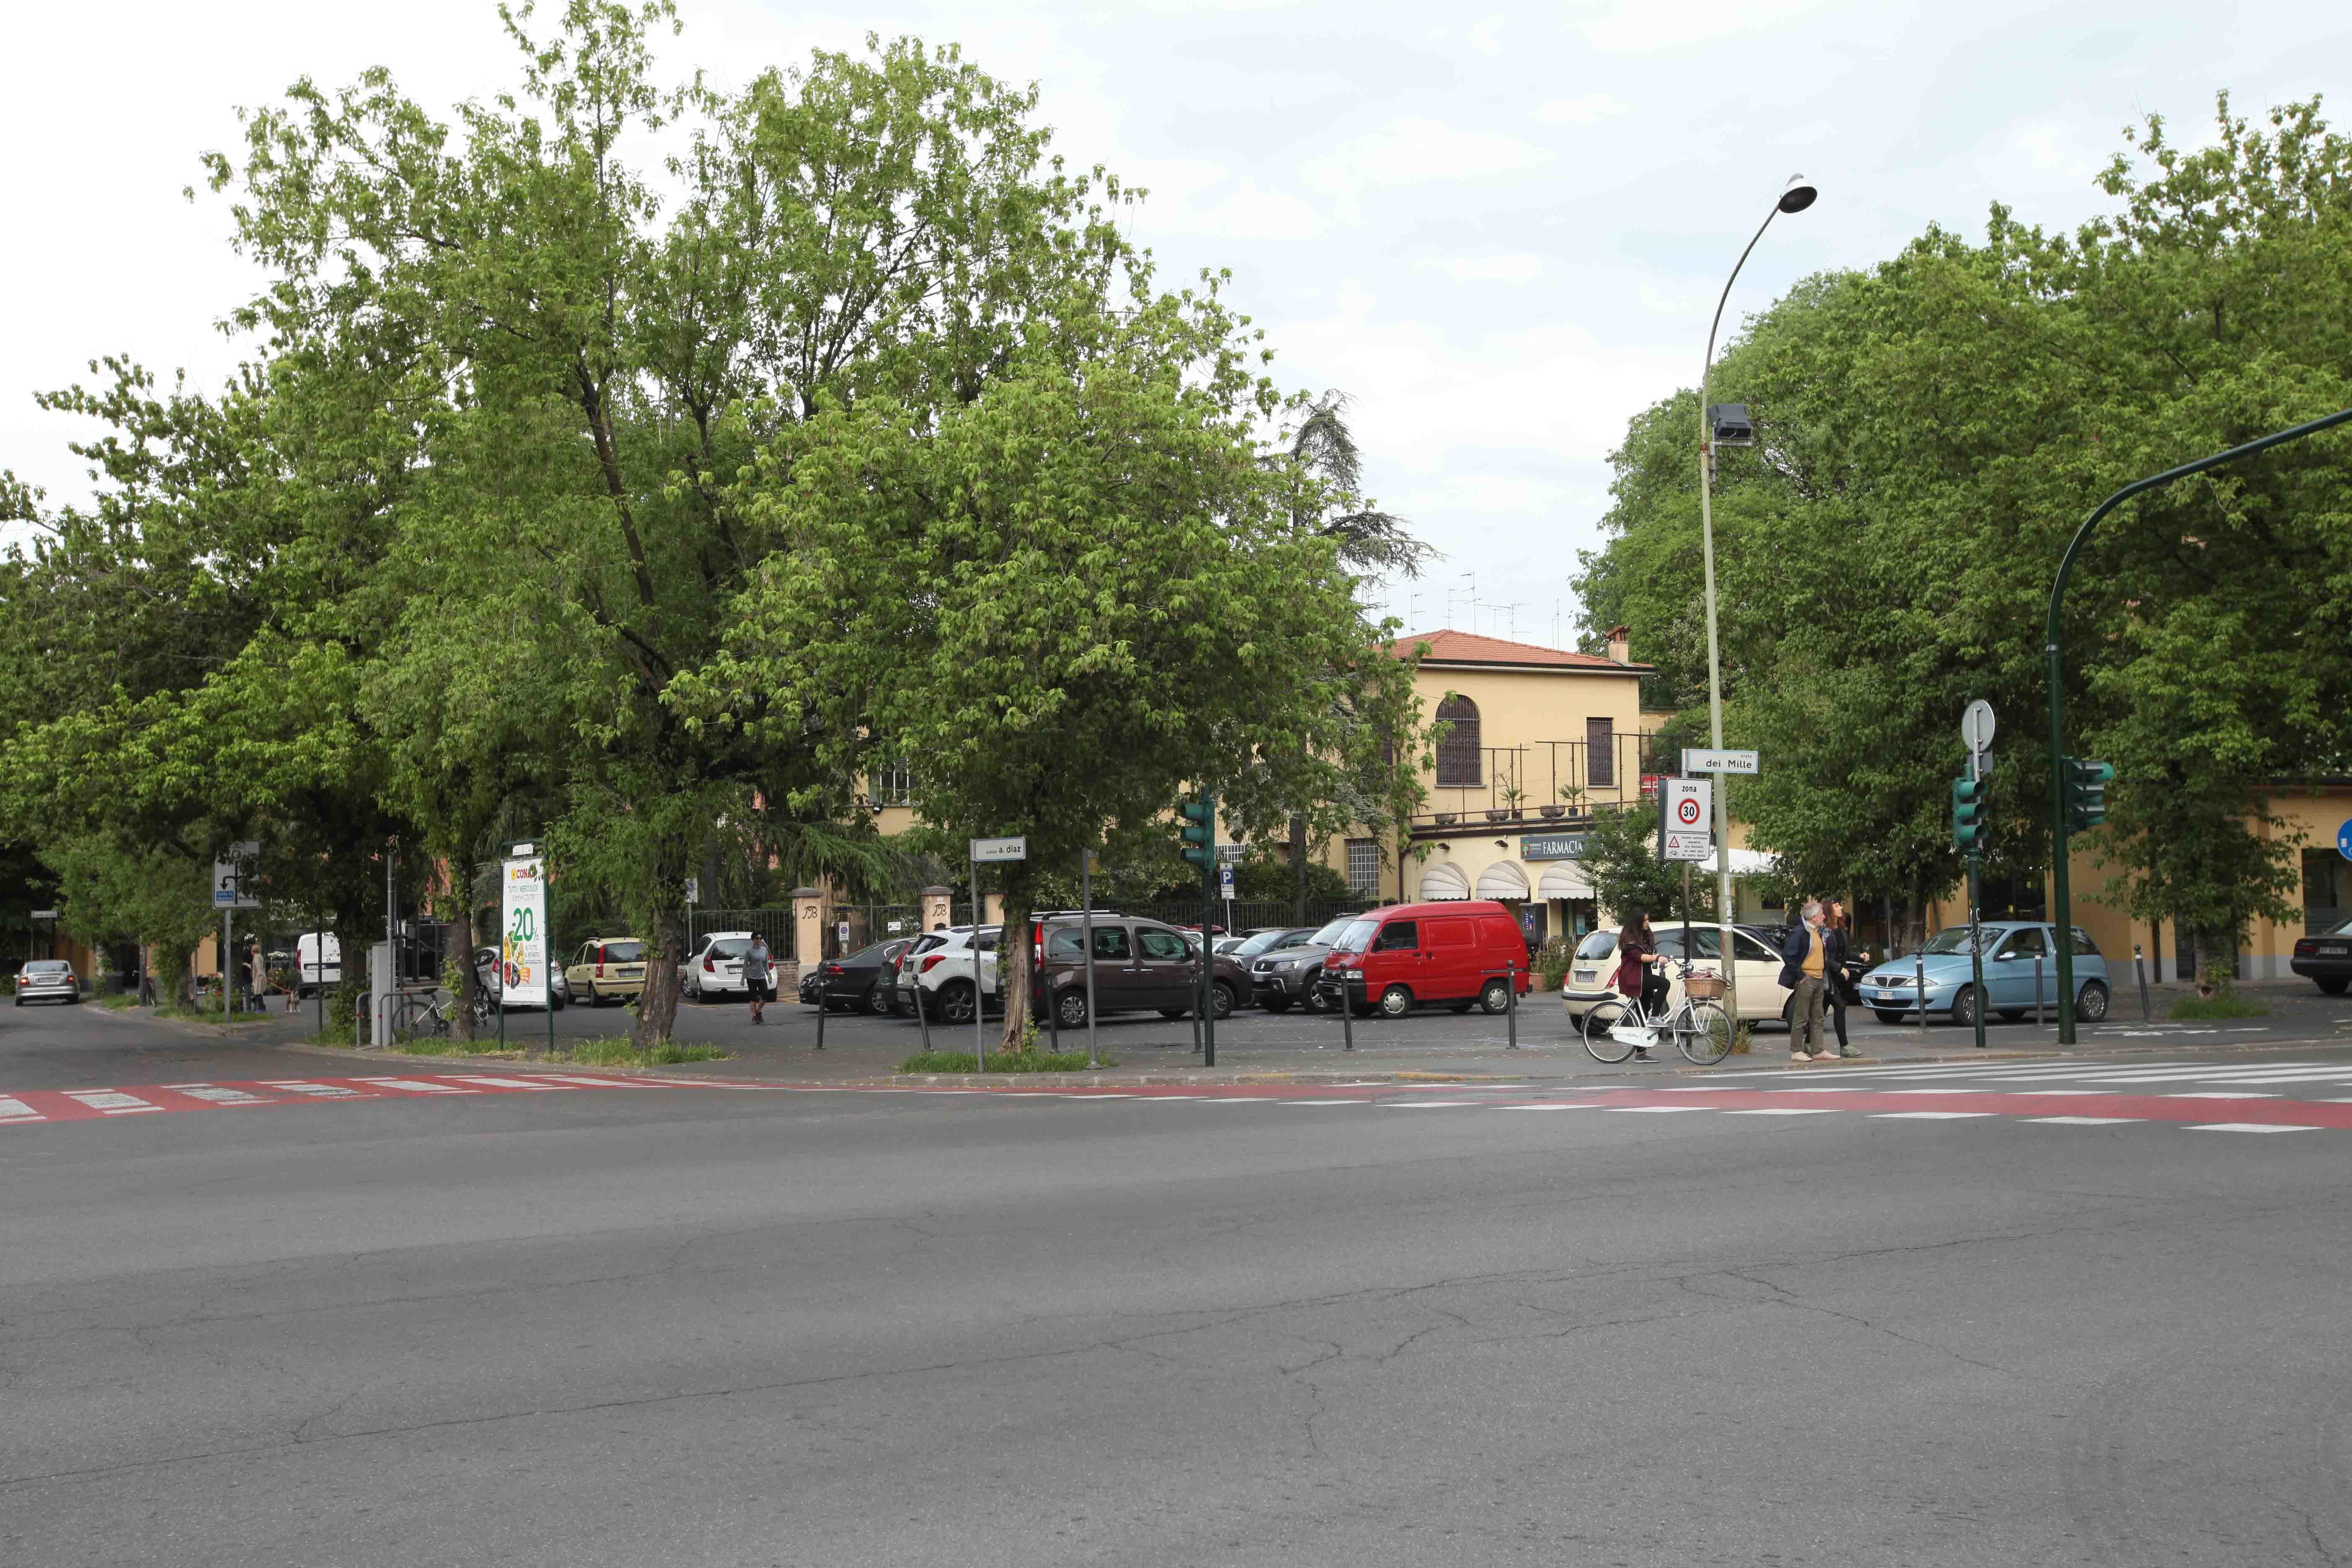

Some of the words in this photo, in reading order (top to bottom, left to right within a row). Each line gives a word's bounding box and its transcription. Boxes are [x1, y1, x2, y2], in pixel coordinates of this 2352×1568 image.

[1684, 806, 1694, 817] 30
[1543, 841, 1583, 854] FARMACIA
[1223, 872, 1231, 883] P
